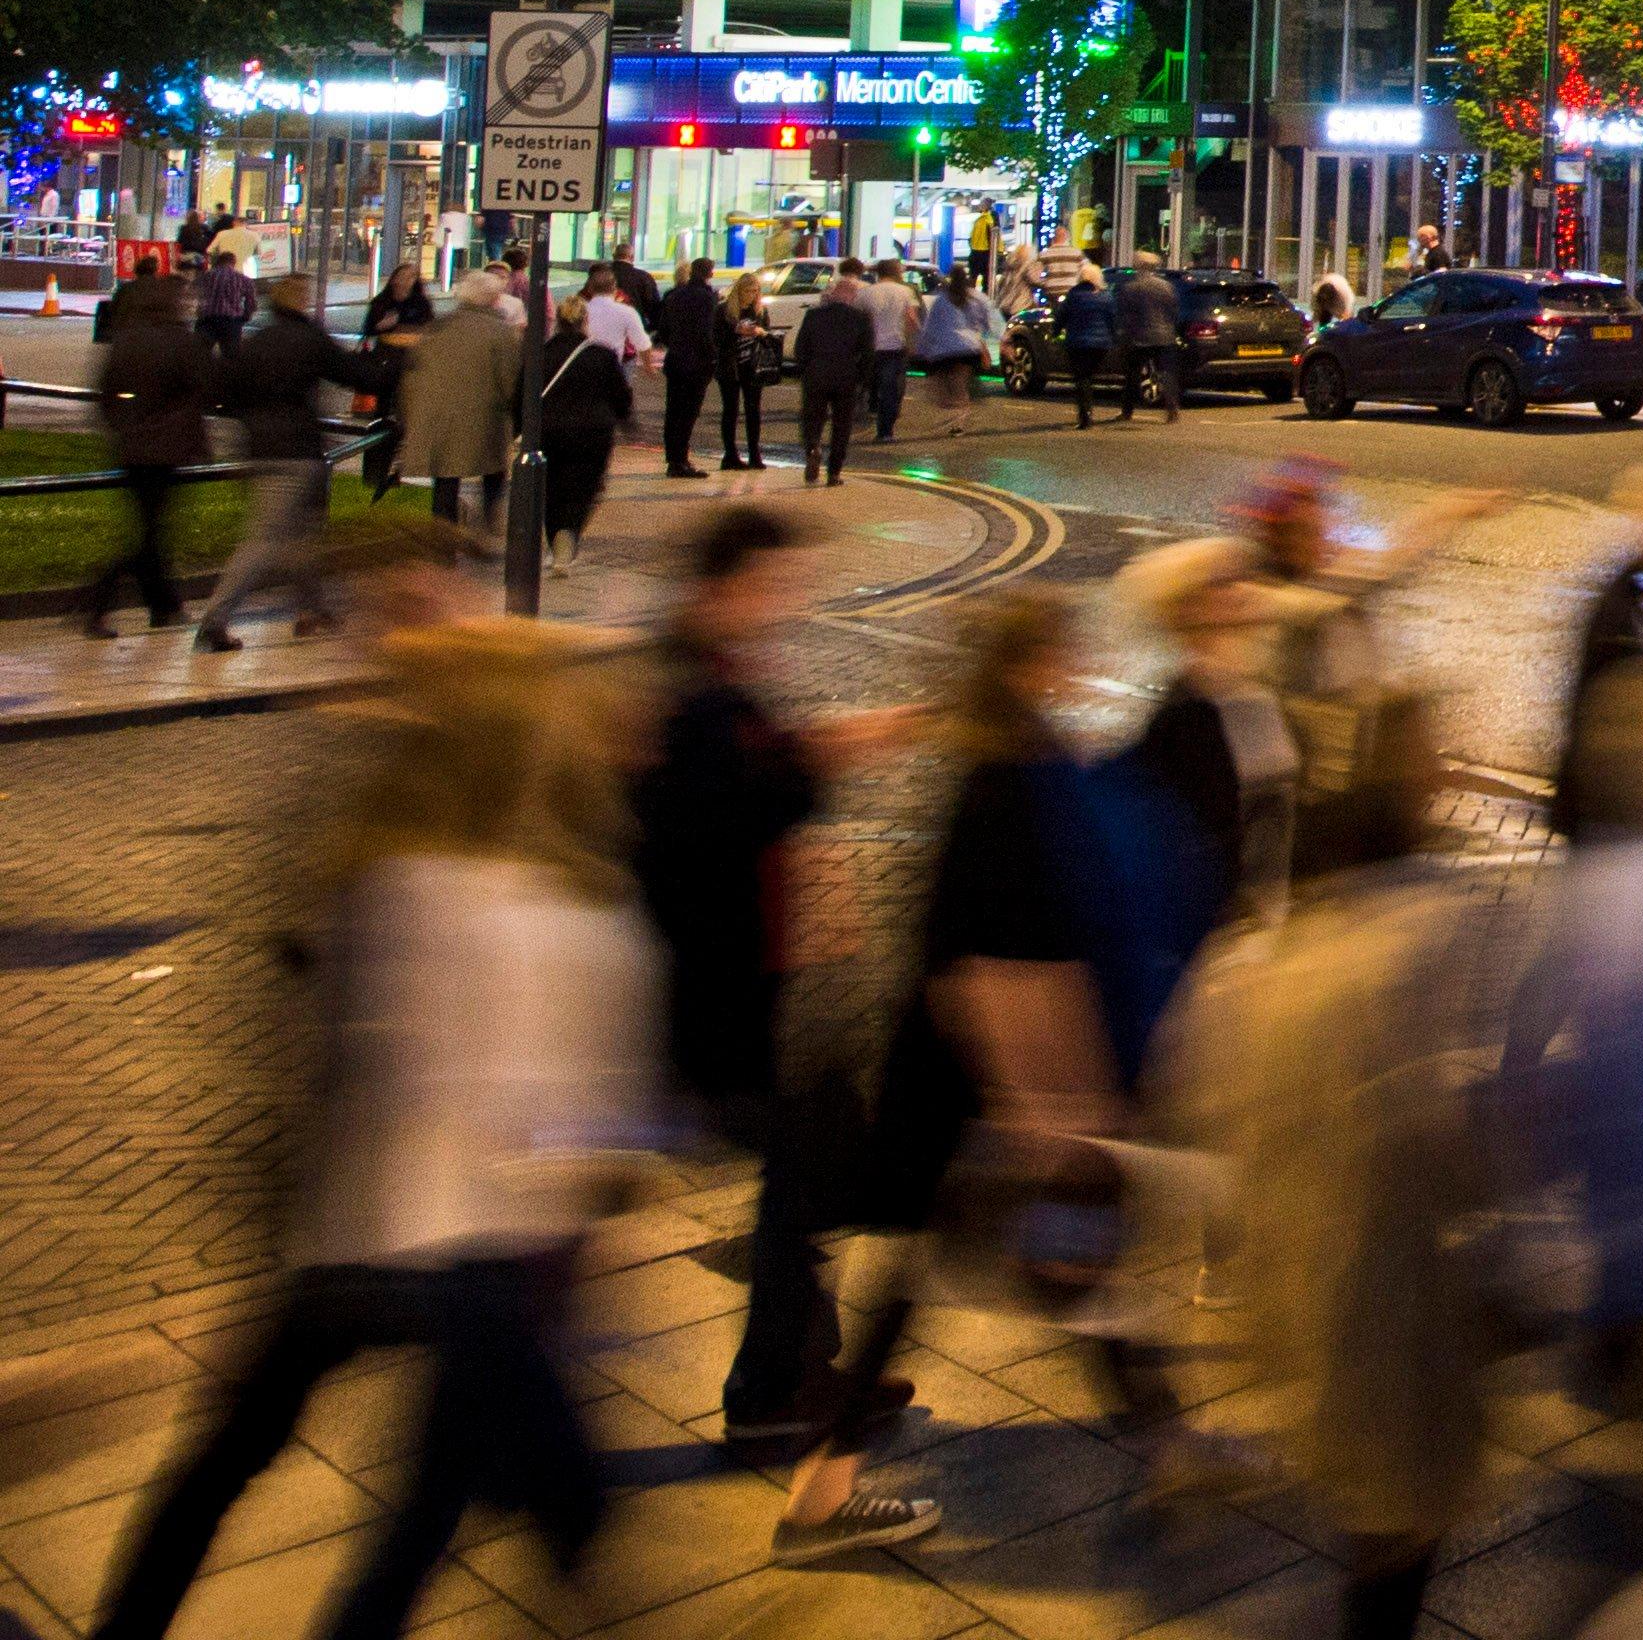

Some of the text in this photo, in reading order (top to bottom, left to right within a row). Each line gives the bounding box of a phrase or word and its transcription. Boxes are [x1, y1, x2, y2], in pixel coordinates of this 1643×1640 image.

[836, 71, 914, 104] Merrion
[491, 133, 592, 150] Pedestrian
[517, 153, 562, 170] Zone
[496, 178, 581, 202] ENDS
